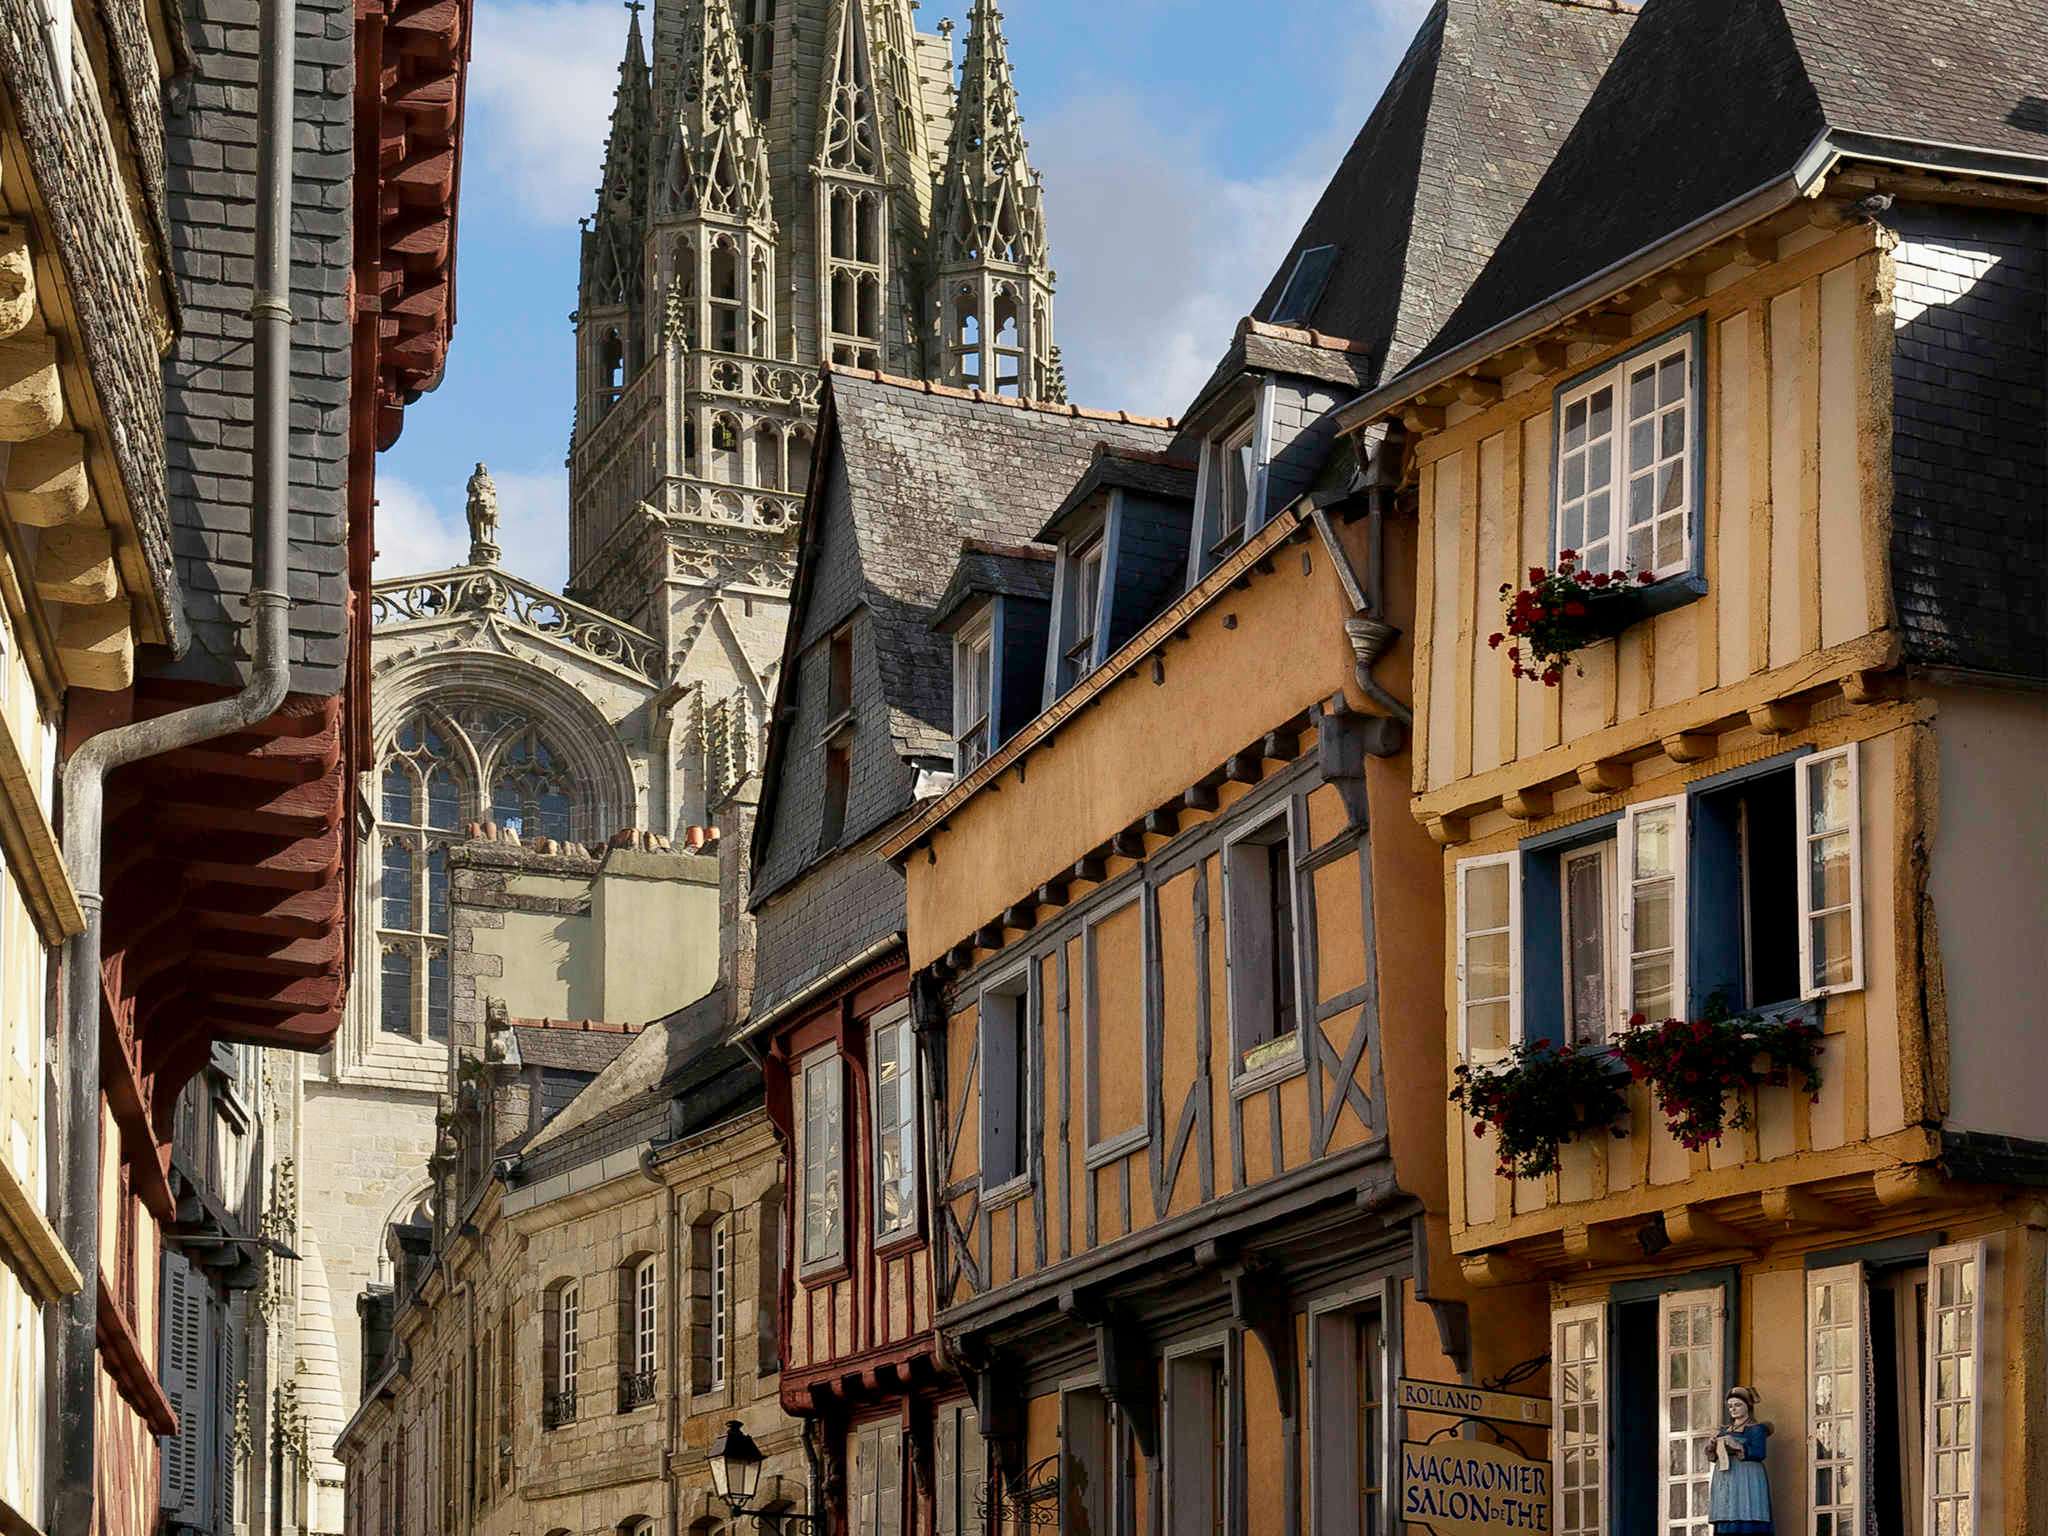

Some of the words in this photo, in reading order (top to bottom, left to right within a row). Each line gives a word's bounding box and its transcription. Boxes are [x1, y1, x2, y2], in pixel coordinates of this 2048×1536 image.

[1405, 1385, 1482, 1411] ROLLAND
[1406, 1453, 1546, 1497] MACARONIER
[1406, 1485, 1489, 1522] SALON
[1491, 1508, 1504, 1520] DE
[1503, 1498, 1548, 1531] THE
